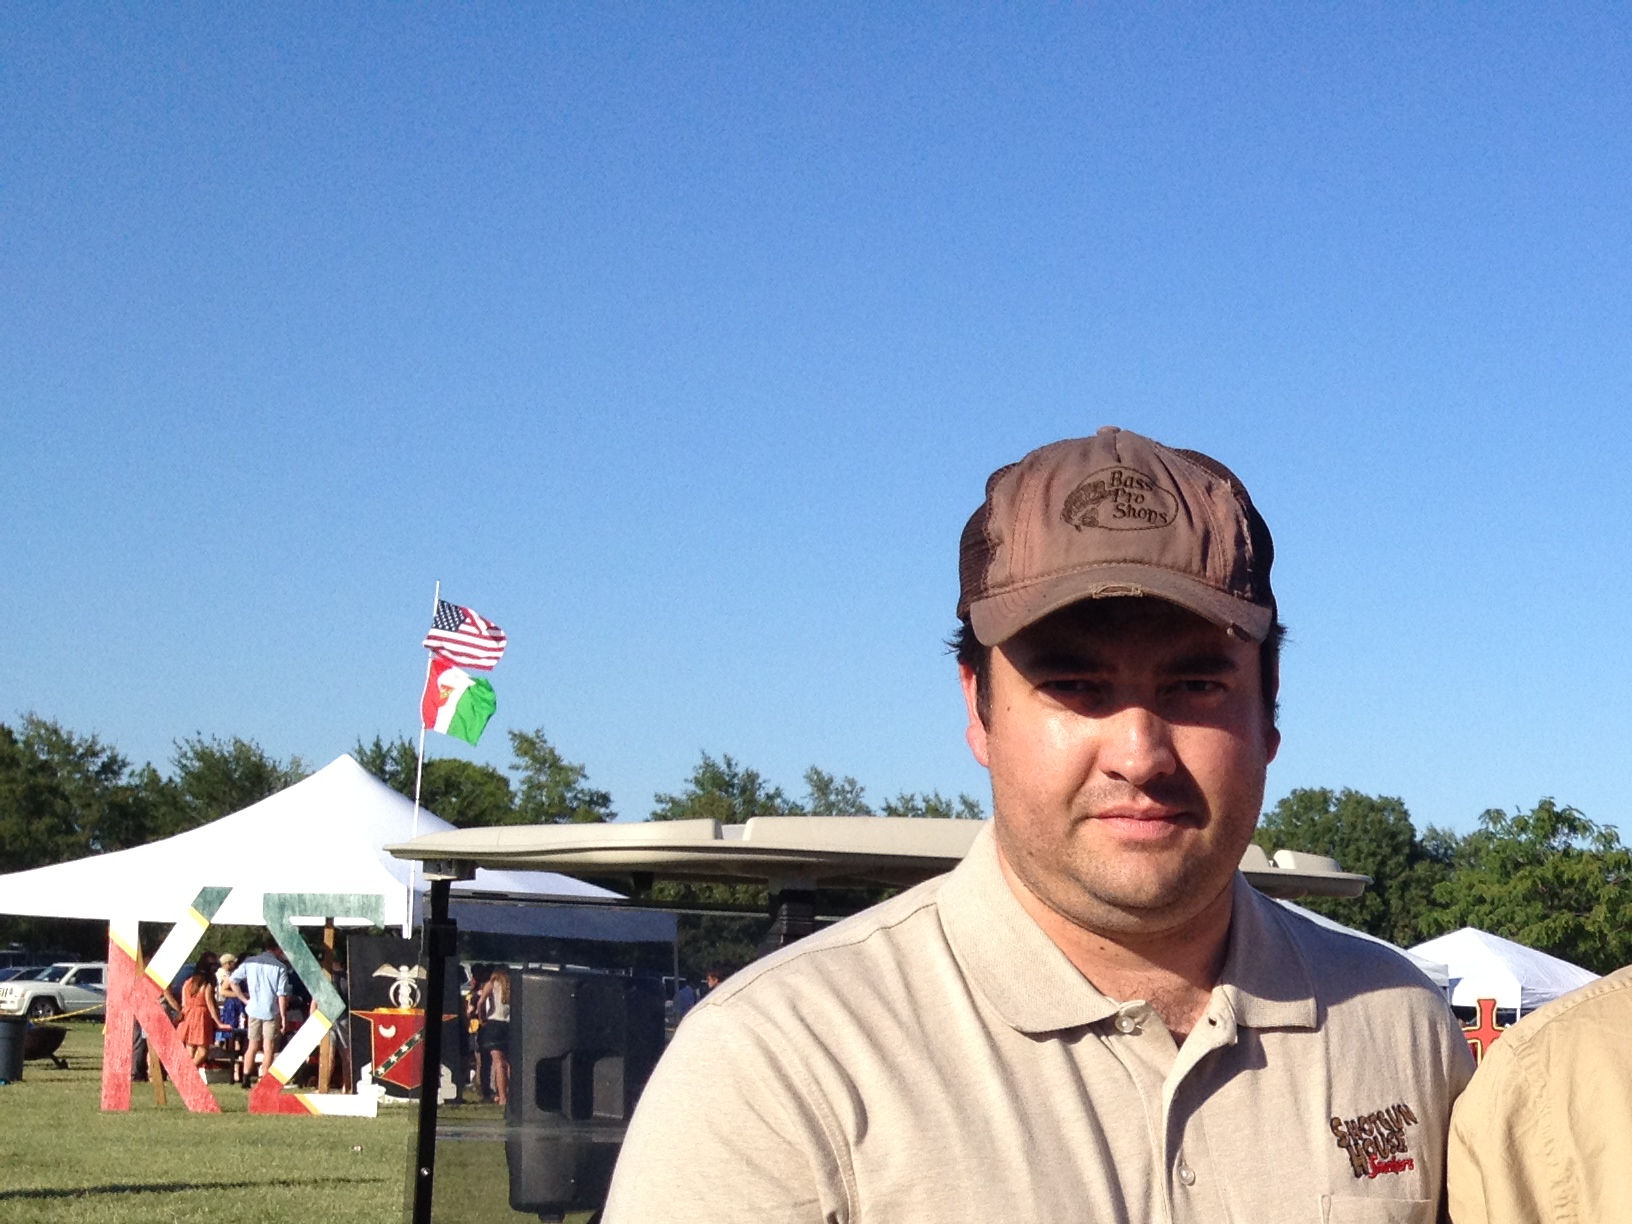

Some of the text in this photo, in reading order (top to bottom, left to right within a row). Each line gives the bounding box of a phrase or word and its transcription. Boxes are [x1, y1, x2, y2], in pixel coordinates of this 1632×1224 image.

[1110, 470, 1154, 491] Bass
[1111, 487, 1145, 504] Pro
[1112, 502, 1168, 523] Shops
